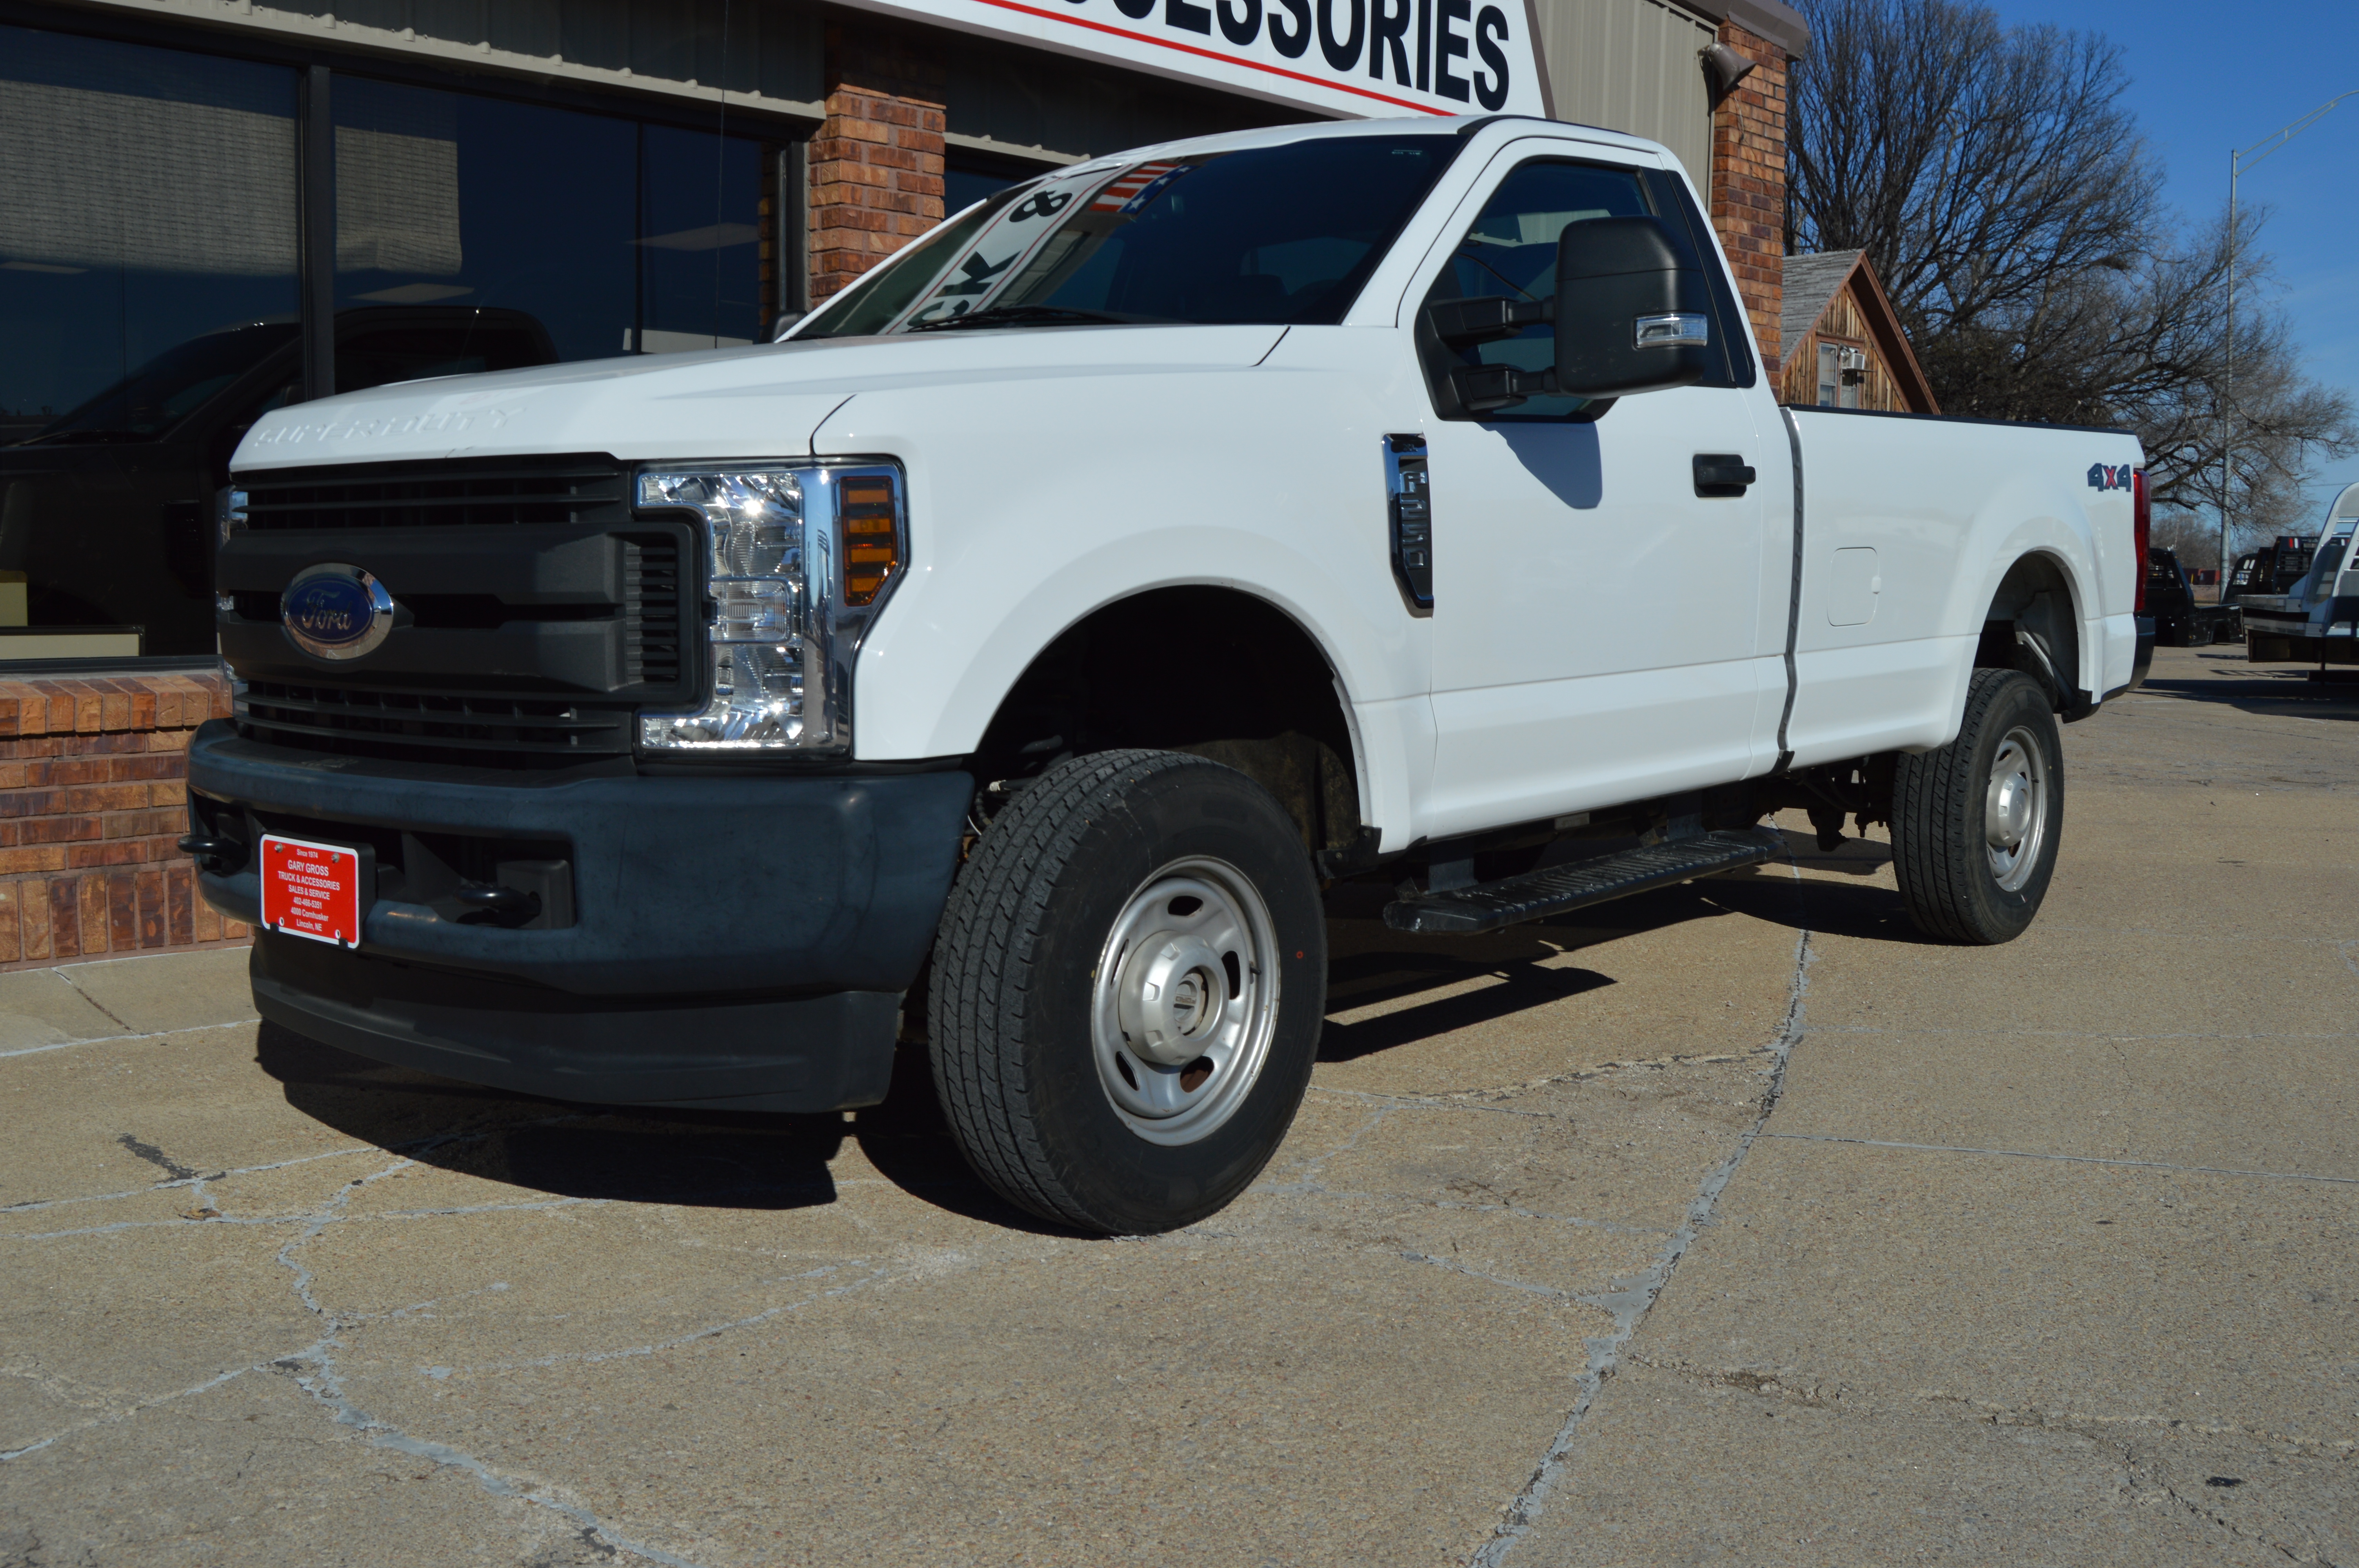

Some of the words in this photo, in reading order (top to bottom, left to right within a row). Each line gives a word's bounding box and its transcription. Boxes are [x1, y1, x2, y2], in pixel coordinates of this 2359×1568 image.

[1065, 0, 1509, 111] ORIES
[381, 408, 527, 436] DUTY
[1403, 443, 1418, 452] XL
[302, 588, 352, 630] Ford
[297, 848, 308, 857] Since
[308, 851, 318, 859] 1974
[288, 859, 305, 872] GARY
[305, 863, 329, 877] GROSS
[278, 871, 296, 882] TRUCK
[296, 875, 300, 883] &
[301, 875, 340, 891] ACCESSORIES
[289, 884, 304, 895] SALES
[304, 887, 308, 896] &
[309, 889, 330, 900] SERVICE
[293, 897, 322, 909] 402-466-5351
[291, 907, 302, 916] 4000
[302, 909, 329, 922] Cornhusker
[296, 919, 314, 931] Lincoln,
[315, 923, 322, 931] NE
